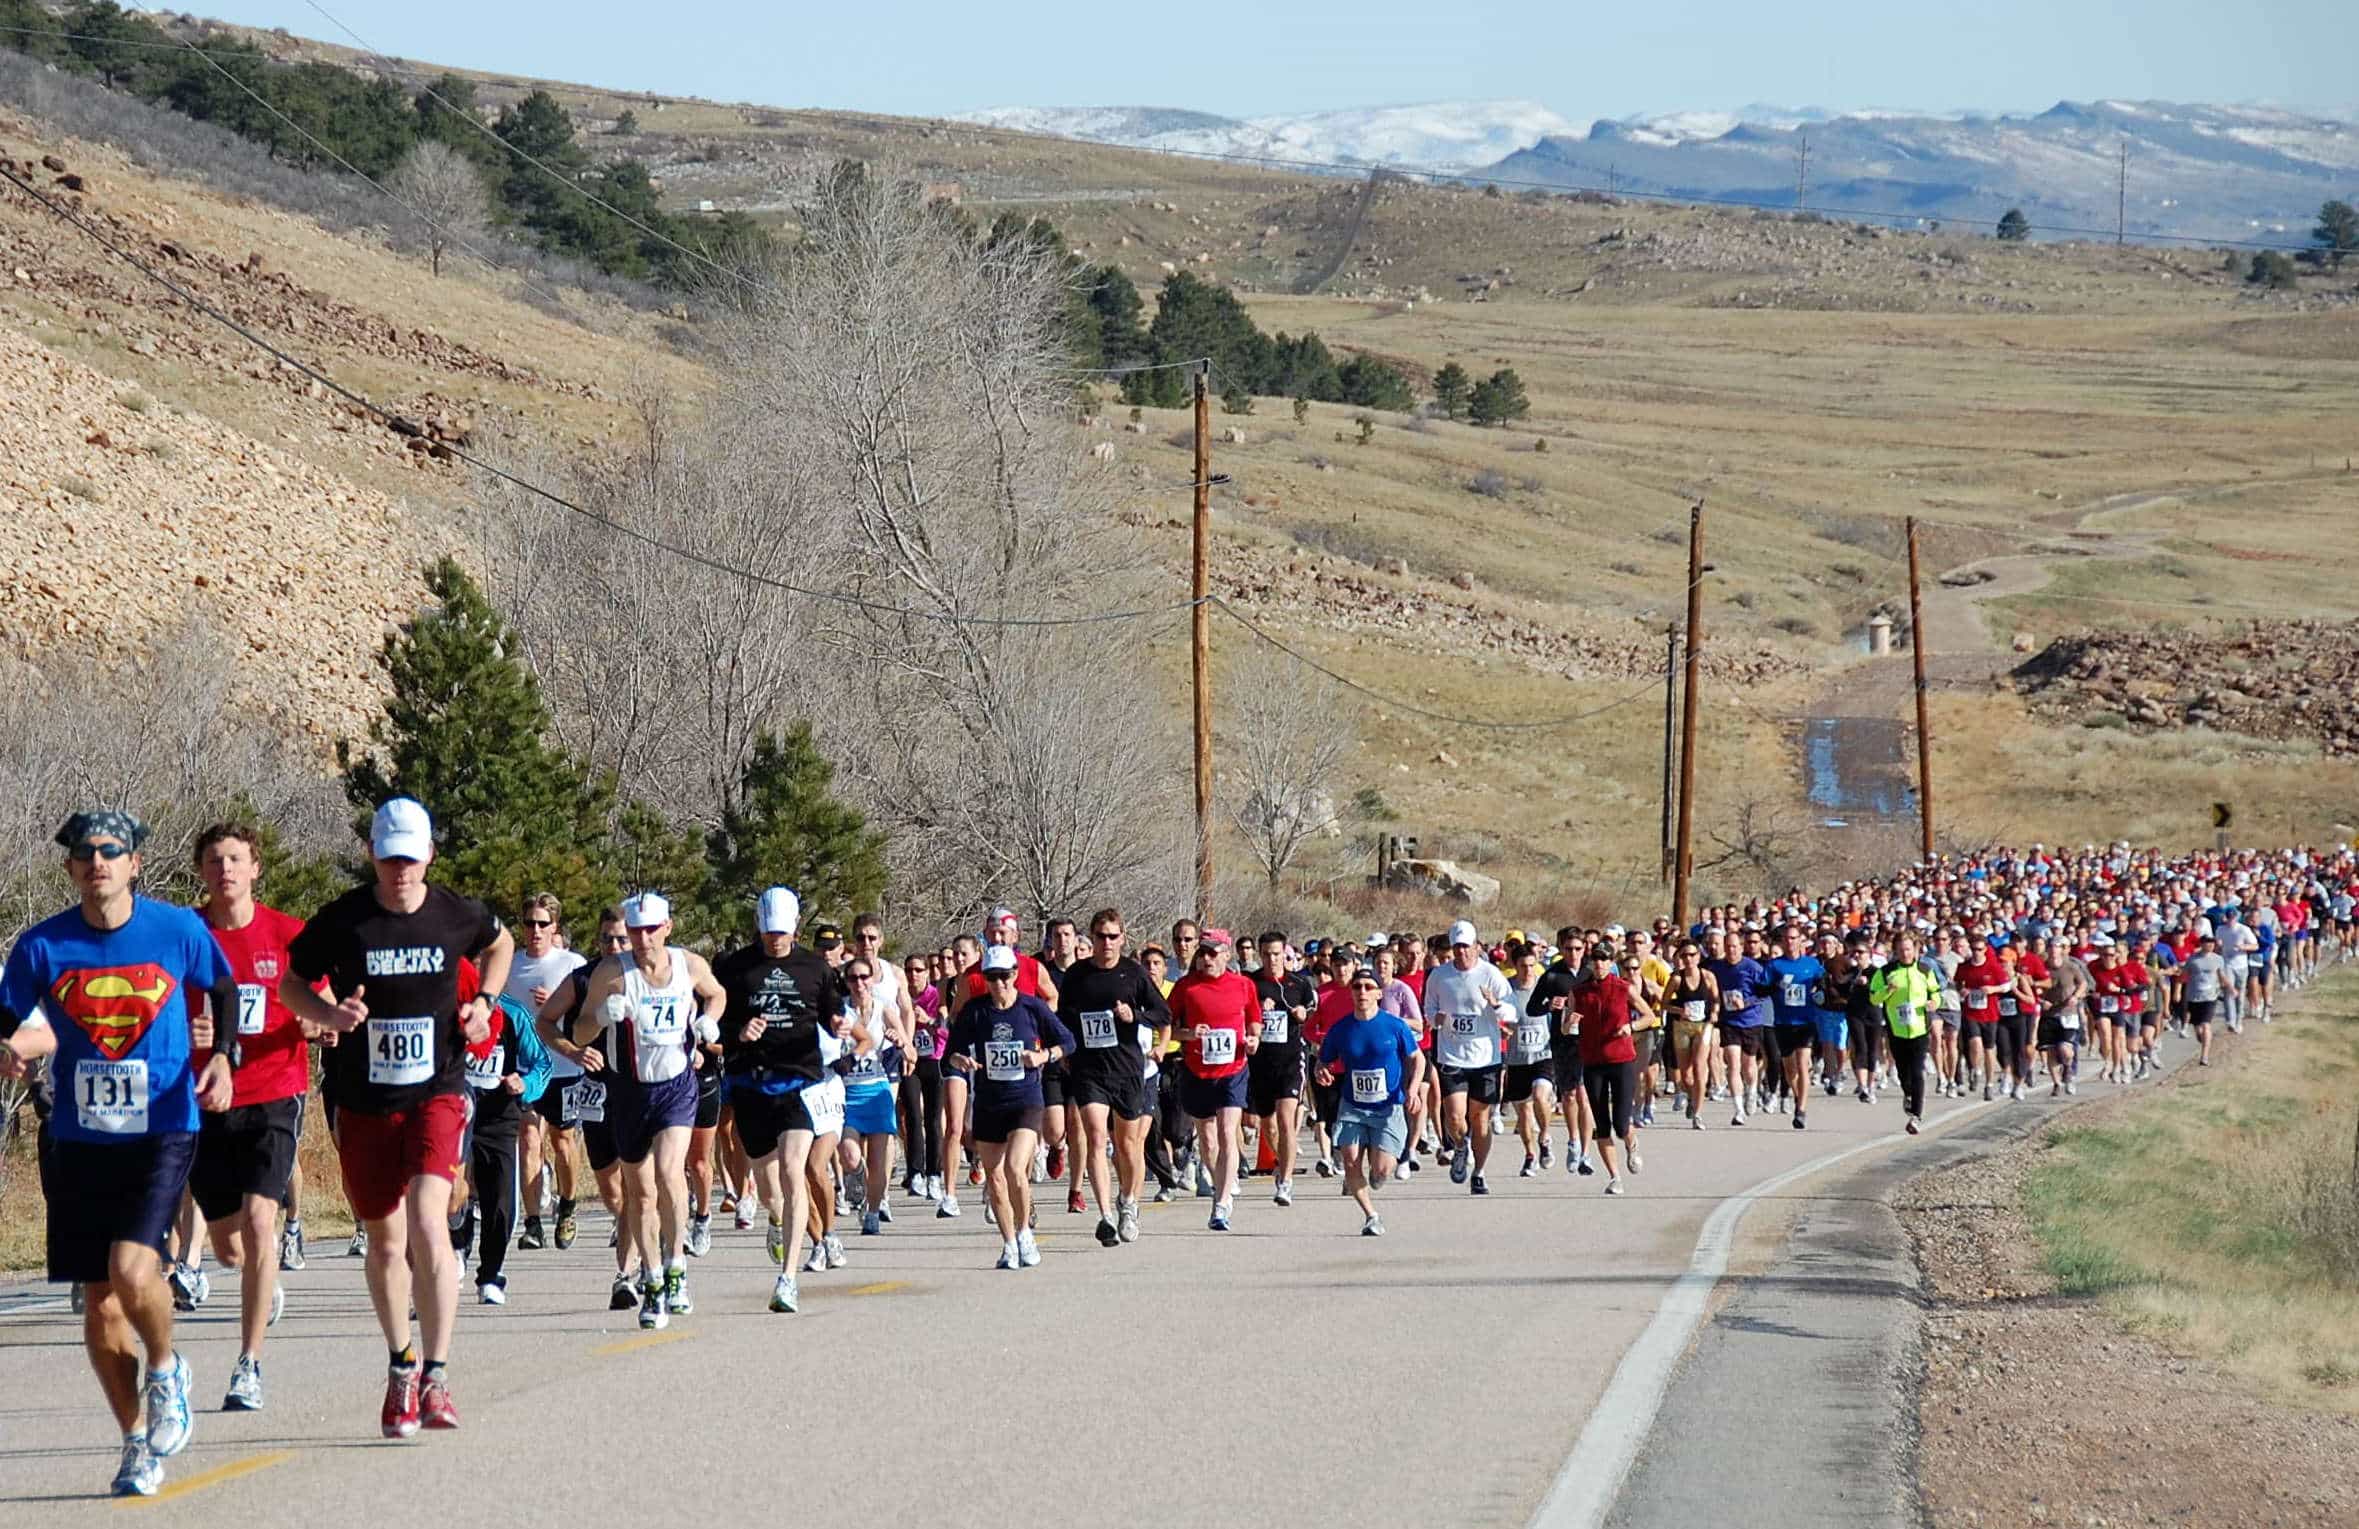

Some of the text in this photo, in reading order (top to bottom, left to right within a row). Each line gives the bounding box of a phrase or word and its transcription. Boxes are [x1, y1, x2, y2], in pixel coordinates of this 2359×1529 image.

[366, 946, 445, 961] RUN LIKE A
[652, 1005, 675, 1028] 74
[372, 1021, 430, 1032] HORSETOOTH
[1086, 1019, 1112, 1036] 178
[1452, 1019, 1474, 1032] 465
[1207, 1036, 1232, 1052] 114
[1521, 1031, 1540, 1043] 417
[377, 1033, 424, 1061] 480
[990, 1049, 1019, 1067] 250
[85, 1076, 135, 1107] 131
